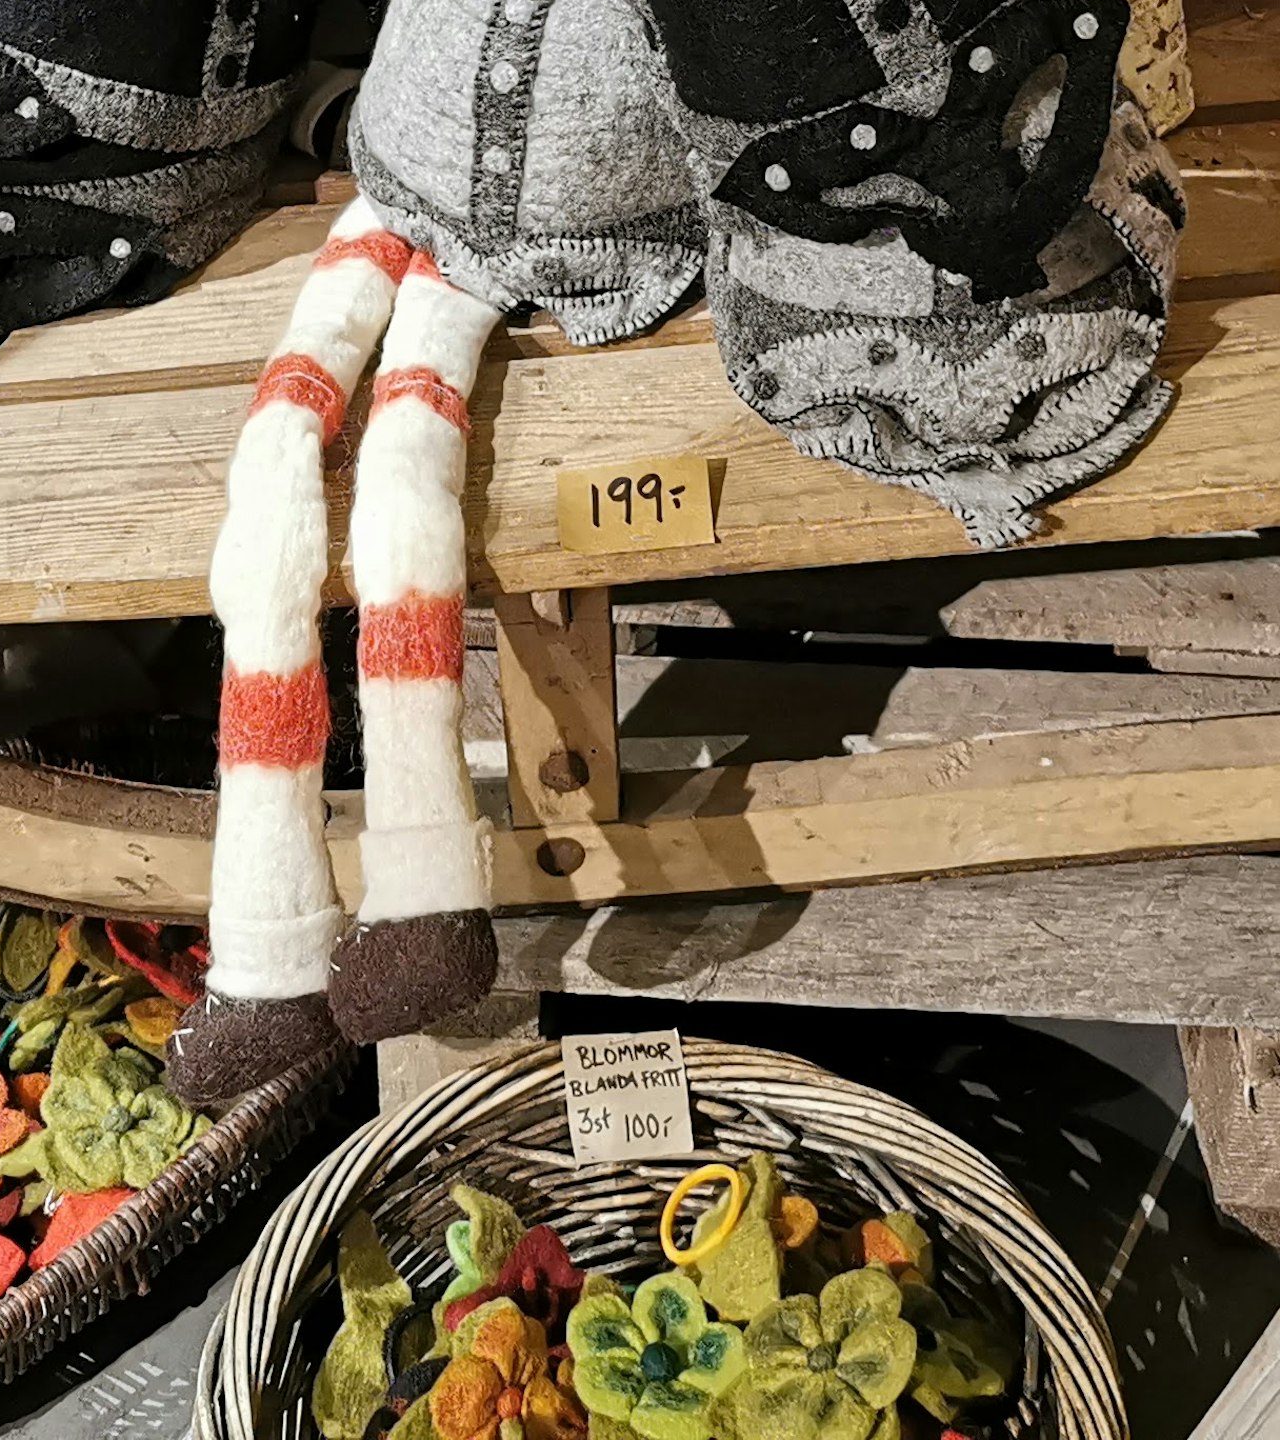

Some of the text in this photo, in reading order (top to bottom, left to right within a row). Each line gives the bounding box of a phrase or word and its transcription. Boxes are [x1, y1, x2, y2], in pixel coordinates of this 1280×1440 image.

[575, 1041, 674, 1070] BLOMMOR
[568, 1066, 683, 1098] BLANDA FRITT
